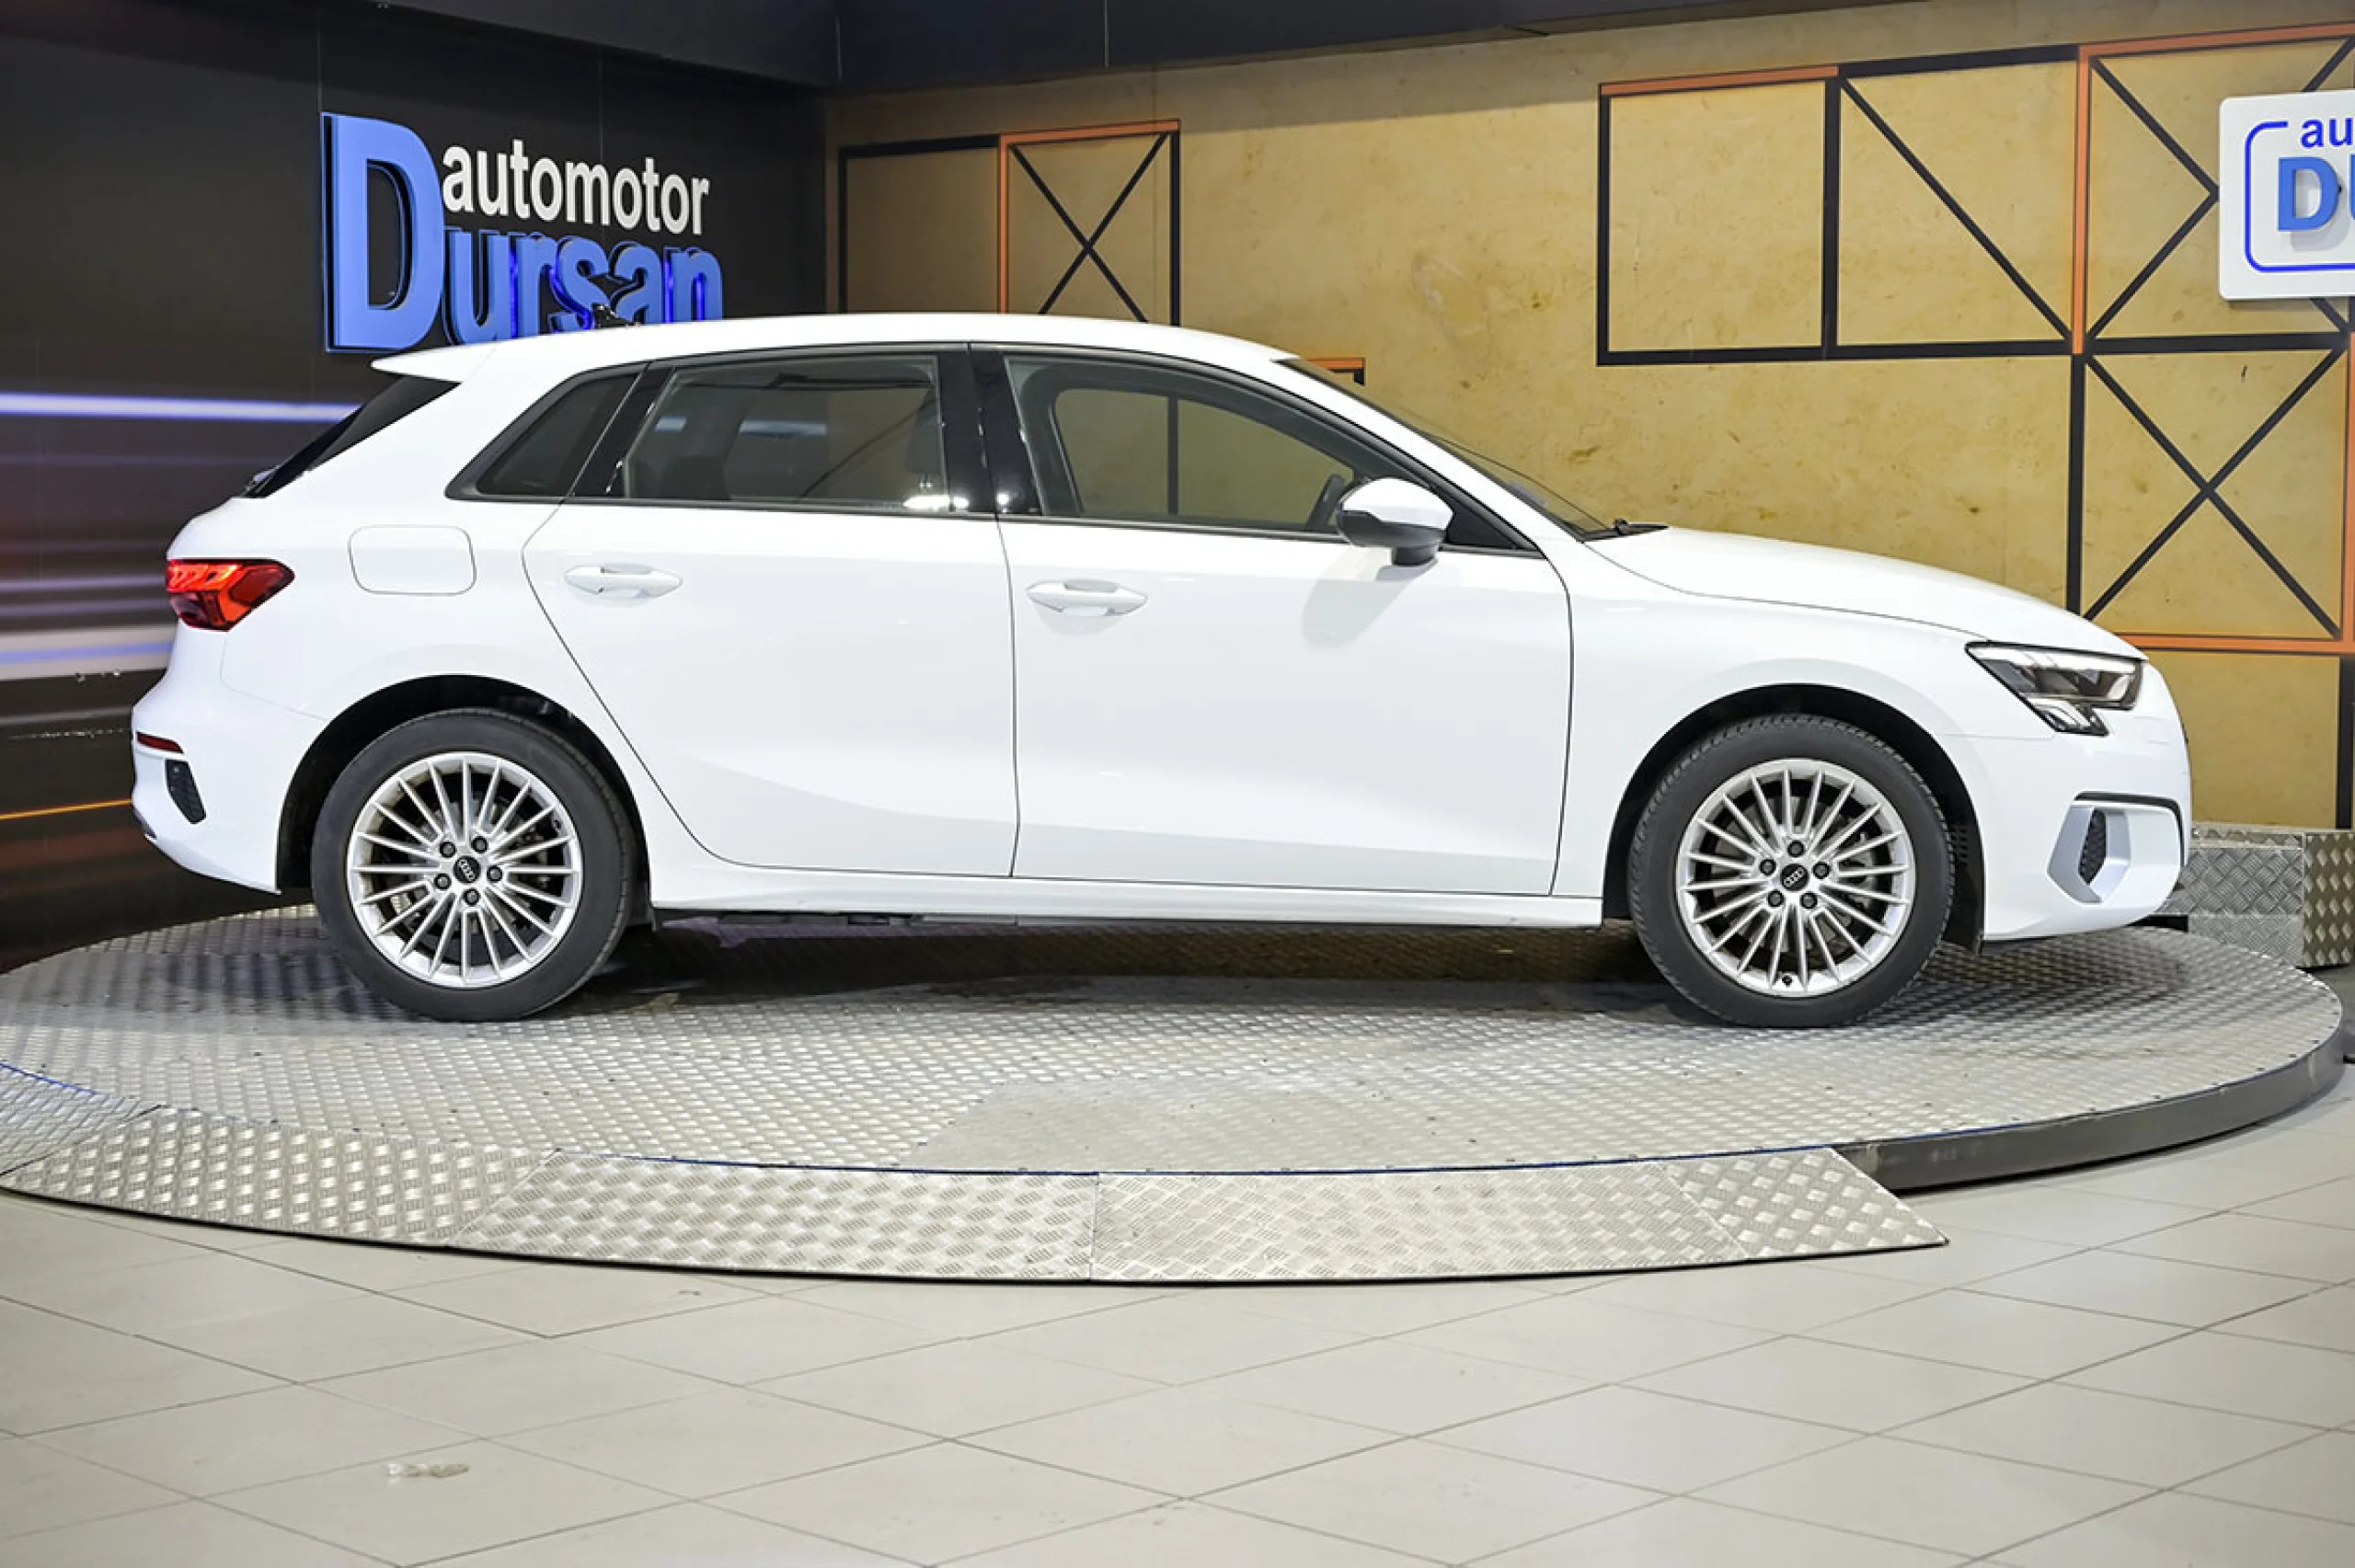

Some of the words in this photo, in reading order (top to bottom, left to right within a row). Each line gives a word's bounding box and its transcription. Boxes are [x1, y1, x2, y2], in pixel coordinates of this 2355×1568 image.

[321, 111, 724, 353] Dursan
[442, 139, 709, 235] automotor
[2278, 153, 2355, 231] D
